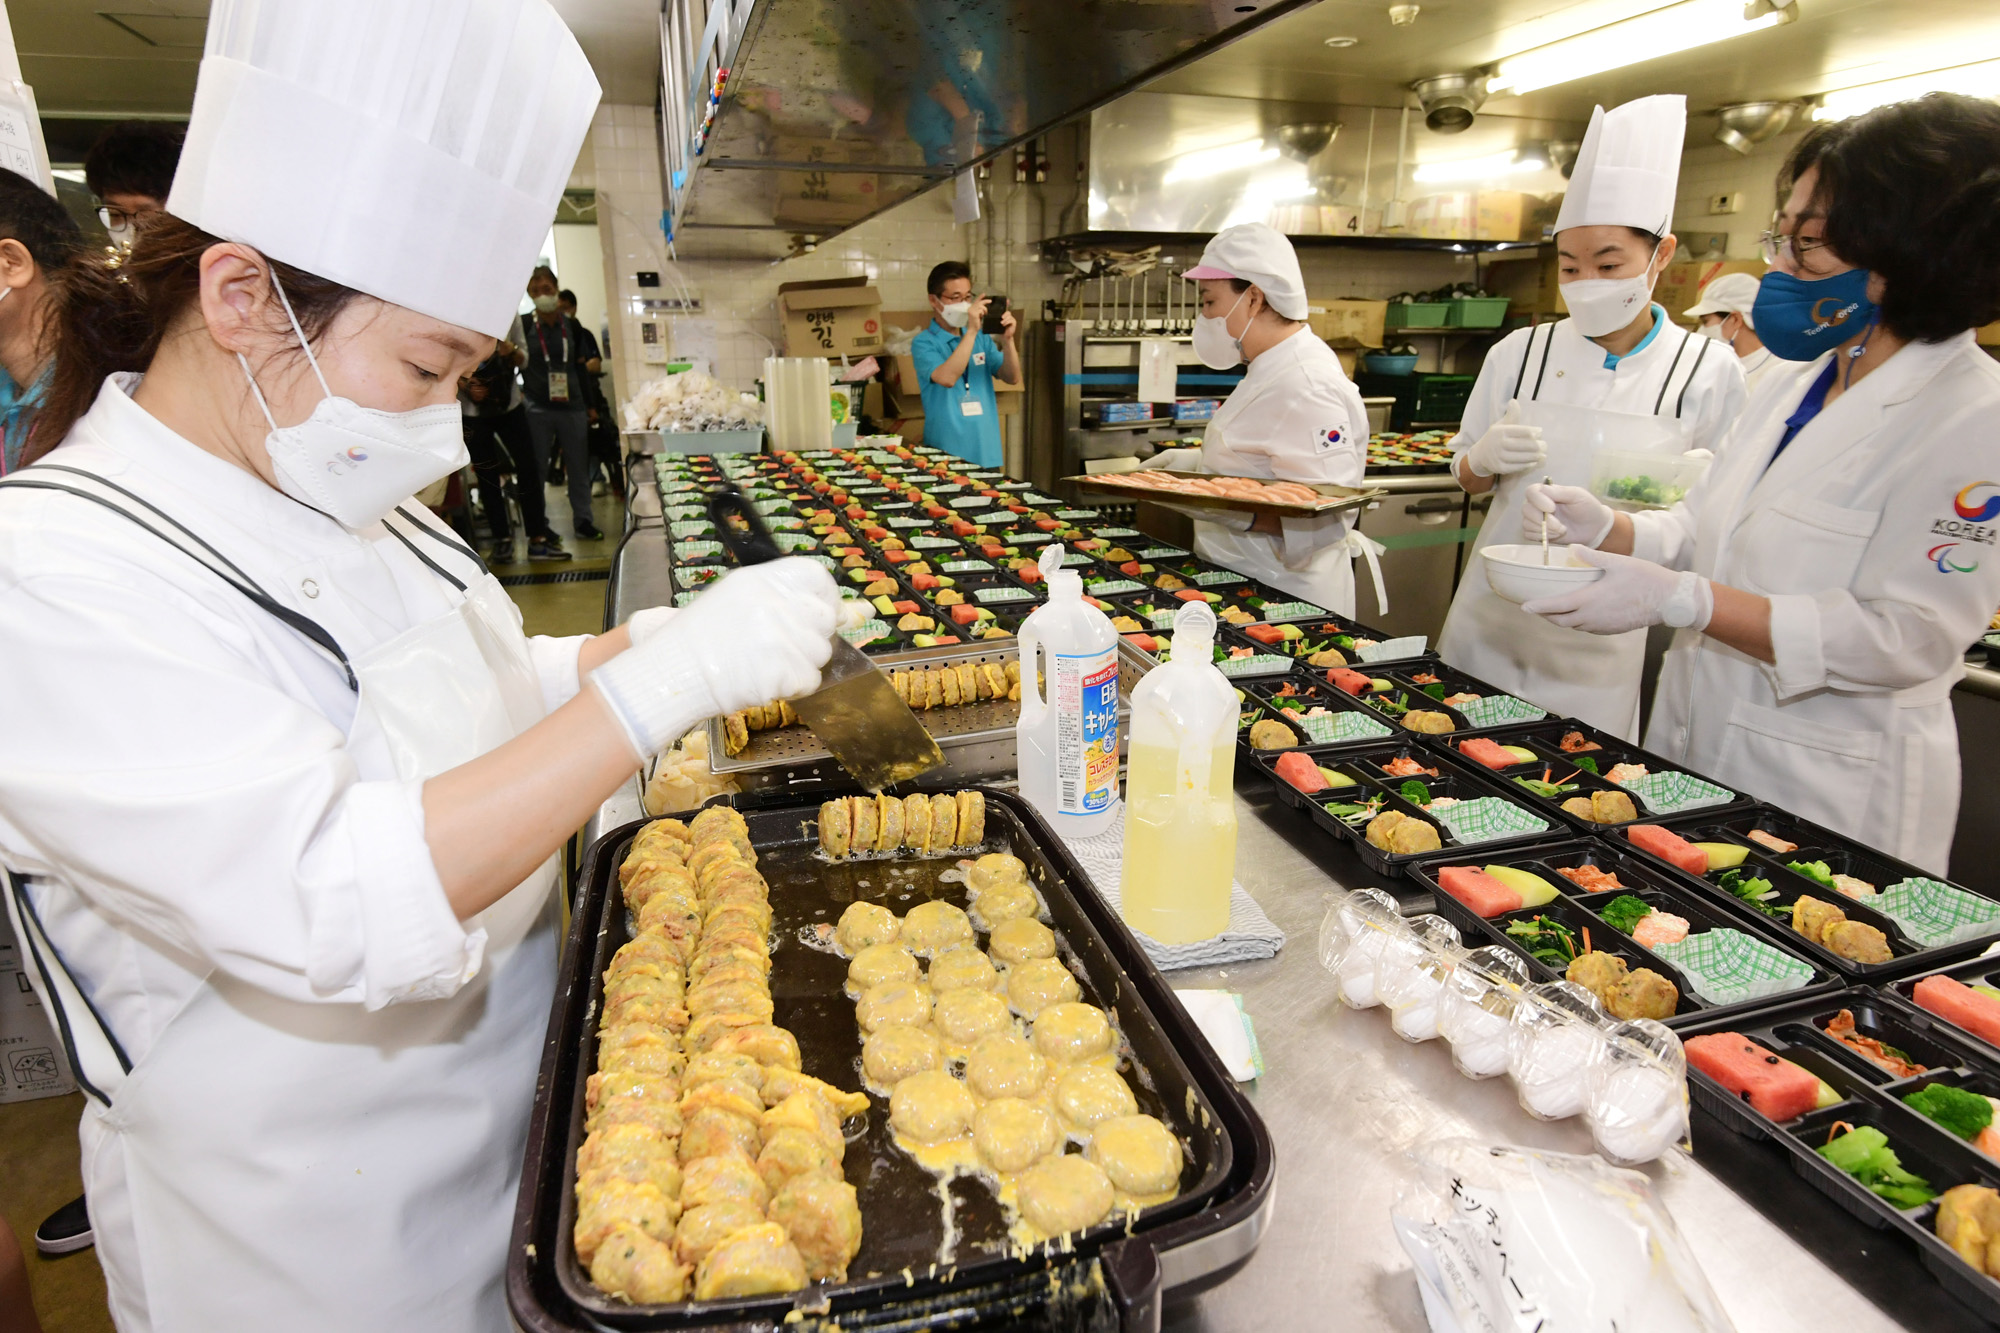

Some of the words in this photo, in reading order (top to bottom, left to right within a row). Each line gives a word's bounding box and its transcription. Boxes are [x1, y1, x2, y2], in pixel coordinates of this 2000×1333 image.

[1347, 215, 1358, 233] 4
[806, 312, 836, 327] 양반
[1802, 320, 1831, 337] Team
[1834, 302, 1860, 320] orea
[811, 326, 835, 350] 김
[1933, 519, 1998, 541] KOREA
